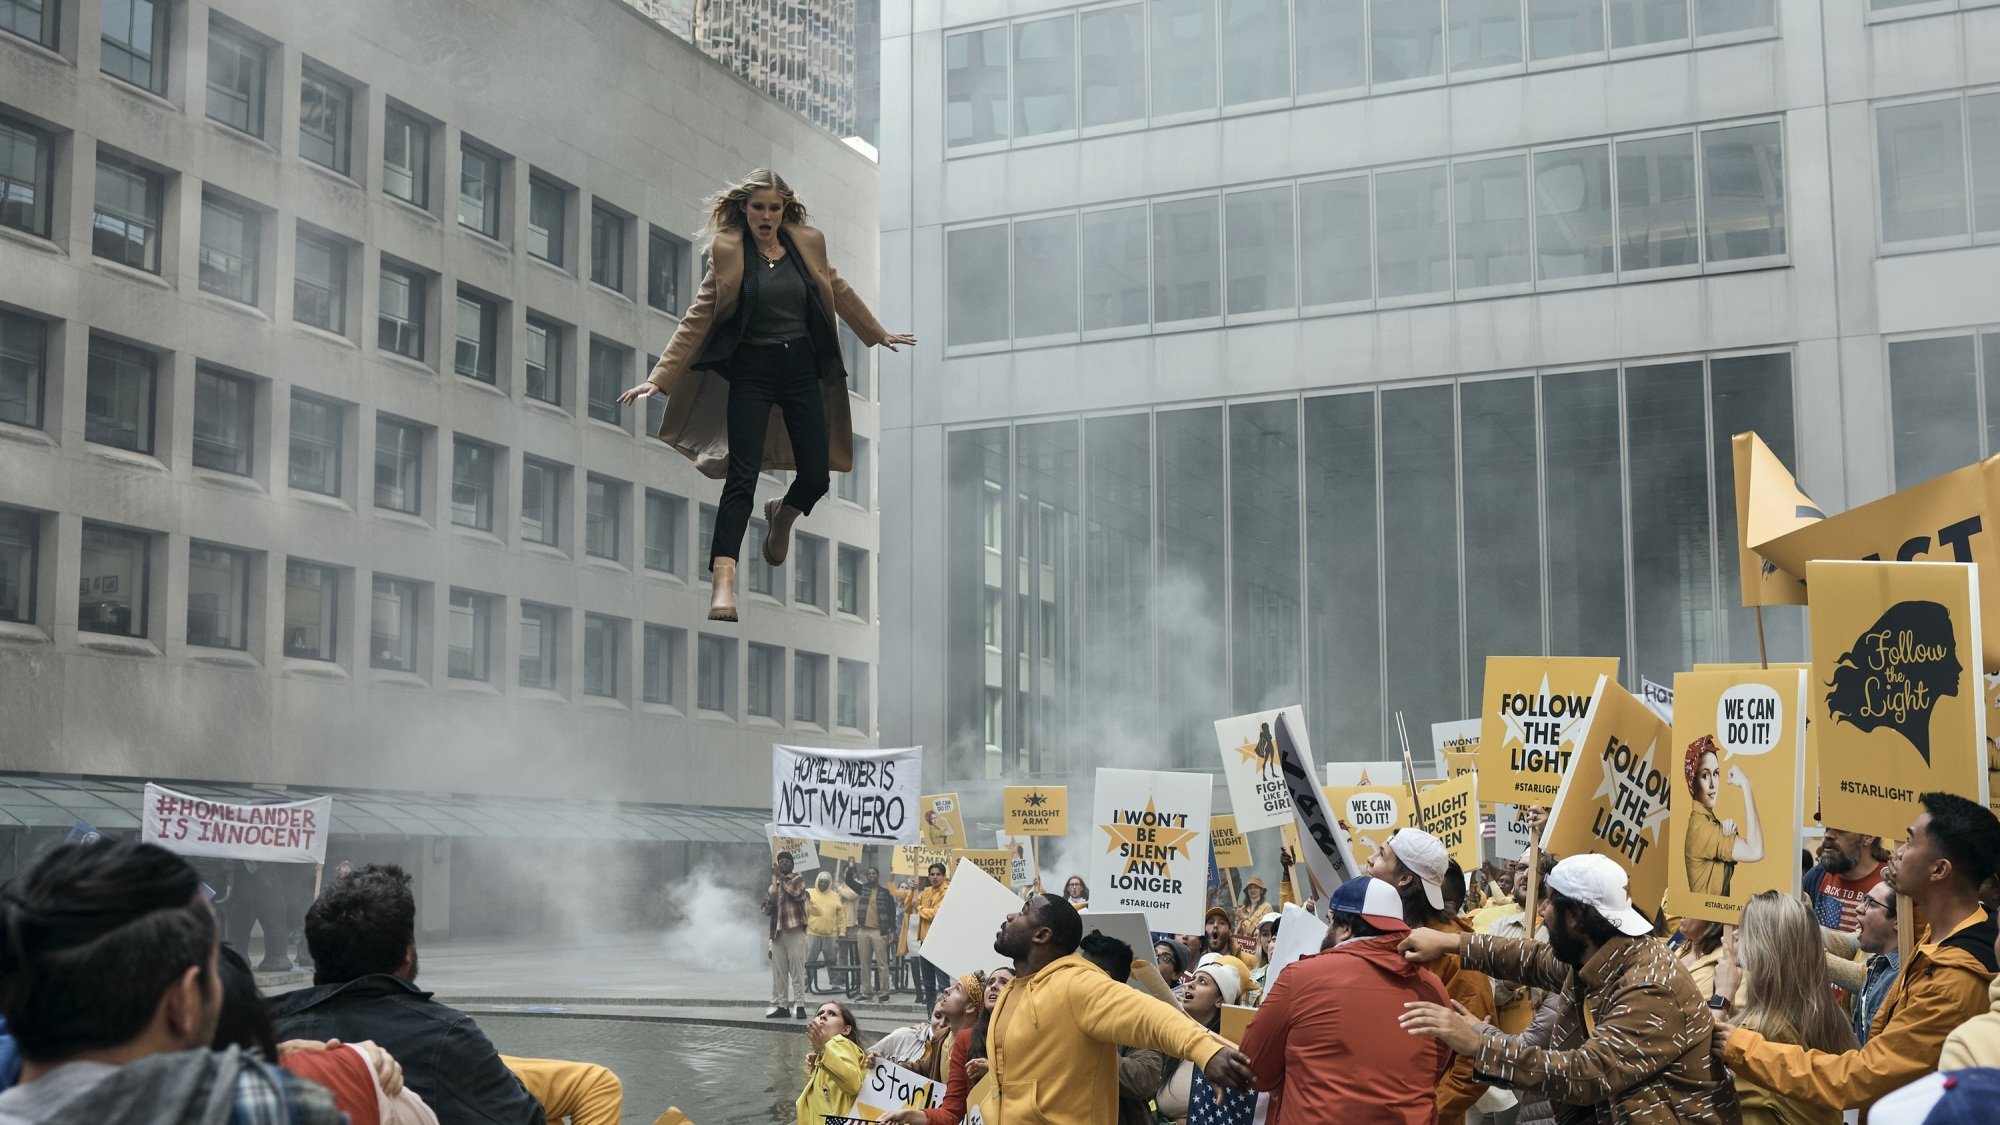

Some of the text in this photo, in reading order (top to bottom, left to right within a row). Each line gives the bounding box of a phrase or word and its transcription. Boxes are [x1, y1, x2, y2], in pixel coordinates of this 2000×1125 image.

[1866, 629, 1947, 671] Follow
[1884, 666, 1905, 683] the
[1501, 693, 1592, 719] FOLLOW
[1724, 698, 1775, 720] WE CAN
[1860, 676, 1930, 724] Light
[1449, 737, 1480, 747] WON'T
[1523, 721, 1561, 746] THE
[1727, 722, 1770, 745] DO IT!
[1511, 748, 1572, 774] LIGHT
[793, 756, 895, 791] HOMELANDER IS
[1256, 780, 1287, 794] FIGH
[1263, 791, 1281, 801] LIKE
[1514, 782, 1561, 794] #STARLIGH
[1840, 780, 1914, 802] #STARLIGHT
[156, 795, 316, 828] #HOMELANDER
[778, 780, 905, 834] NOT MY HERO
[1011, 809, 1060, 817] STARLIGHT
[1264, 798, 1291, 812] GIRL
[1352, 800, 1391, 812] WE CAN
[1613, 782, 1650, 828] THE
[1022, 817, 1049, 825] ARMY
[1113, 809, 1188, 828] I WON'T
[1356, 812, 1390, 825] DO IT!
[158, 818, 316, 850] IS INNOCENT
[1136, 827, 1156, 842] BE
[1591, 807, 1649, 865] LIGHT
[1119, 842, 1178, 861] SILENT
[1012, 872, 1026, 880] GIRL
[1127, 859, 1167, 876] ANY
[1110, 874, 1183, 894] LONGER
[1120, 898, 1171, 909] #STARLIGHT
[1843, 889, 1855, 899] TO
[1856, 892, 1864, 901] B
[1704, 901, 1736, 911] #STARLIGHT
[871, 1064, 943, 1110] Starli
